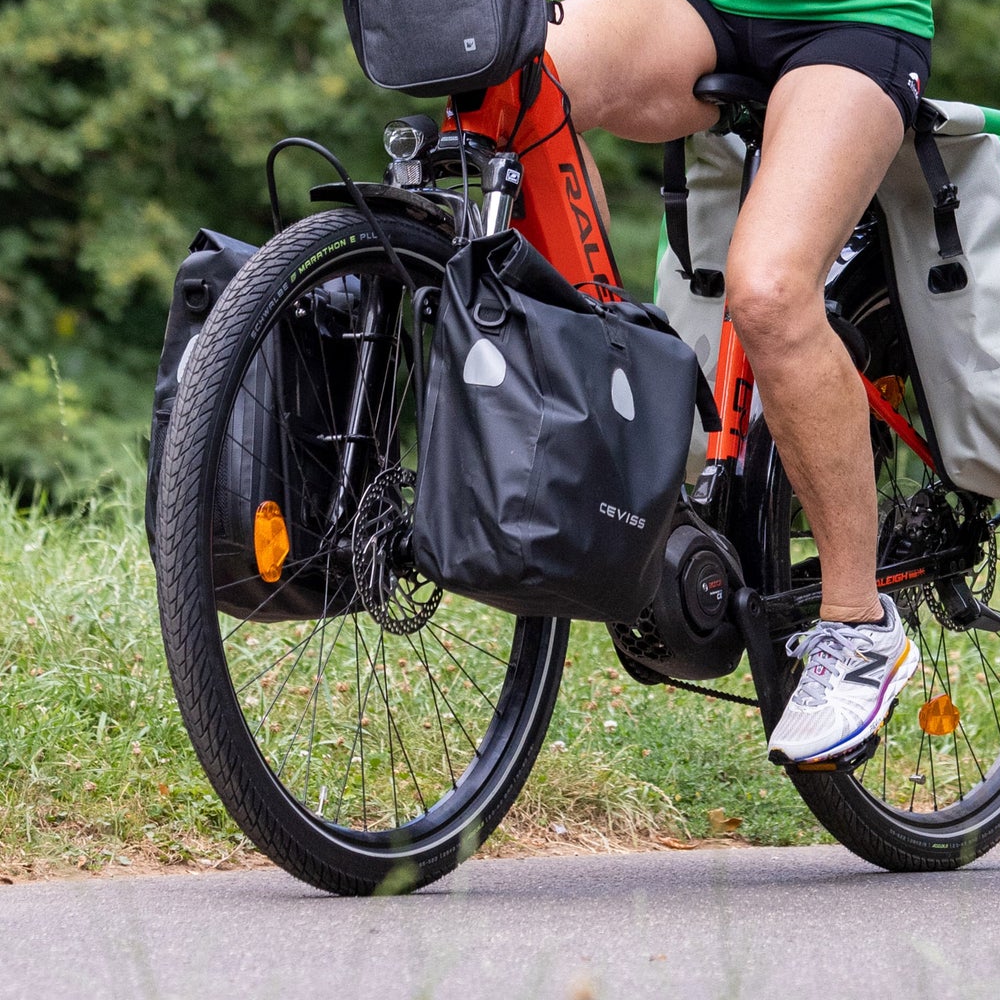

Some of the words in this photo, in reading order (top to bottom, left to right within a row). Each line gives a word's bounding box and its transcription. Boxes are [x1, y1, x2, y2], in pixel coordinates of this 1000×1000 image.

[250, 282, 290, 340] SCHWALBE
[298, 238, 347, 274] MARATHON
[349, 234, 357, 244] E
[599, 501, 646, 529] CEVISS
